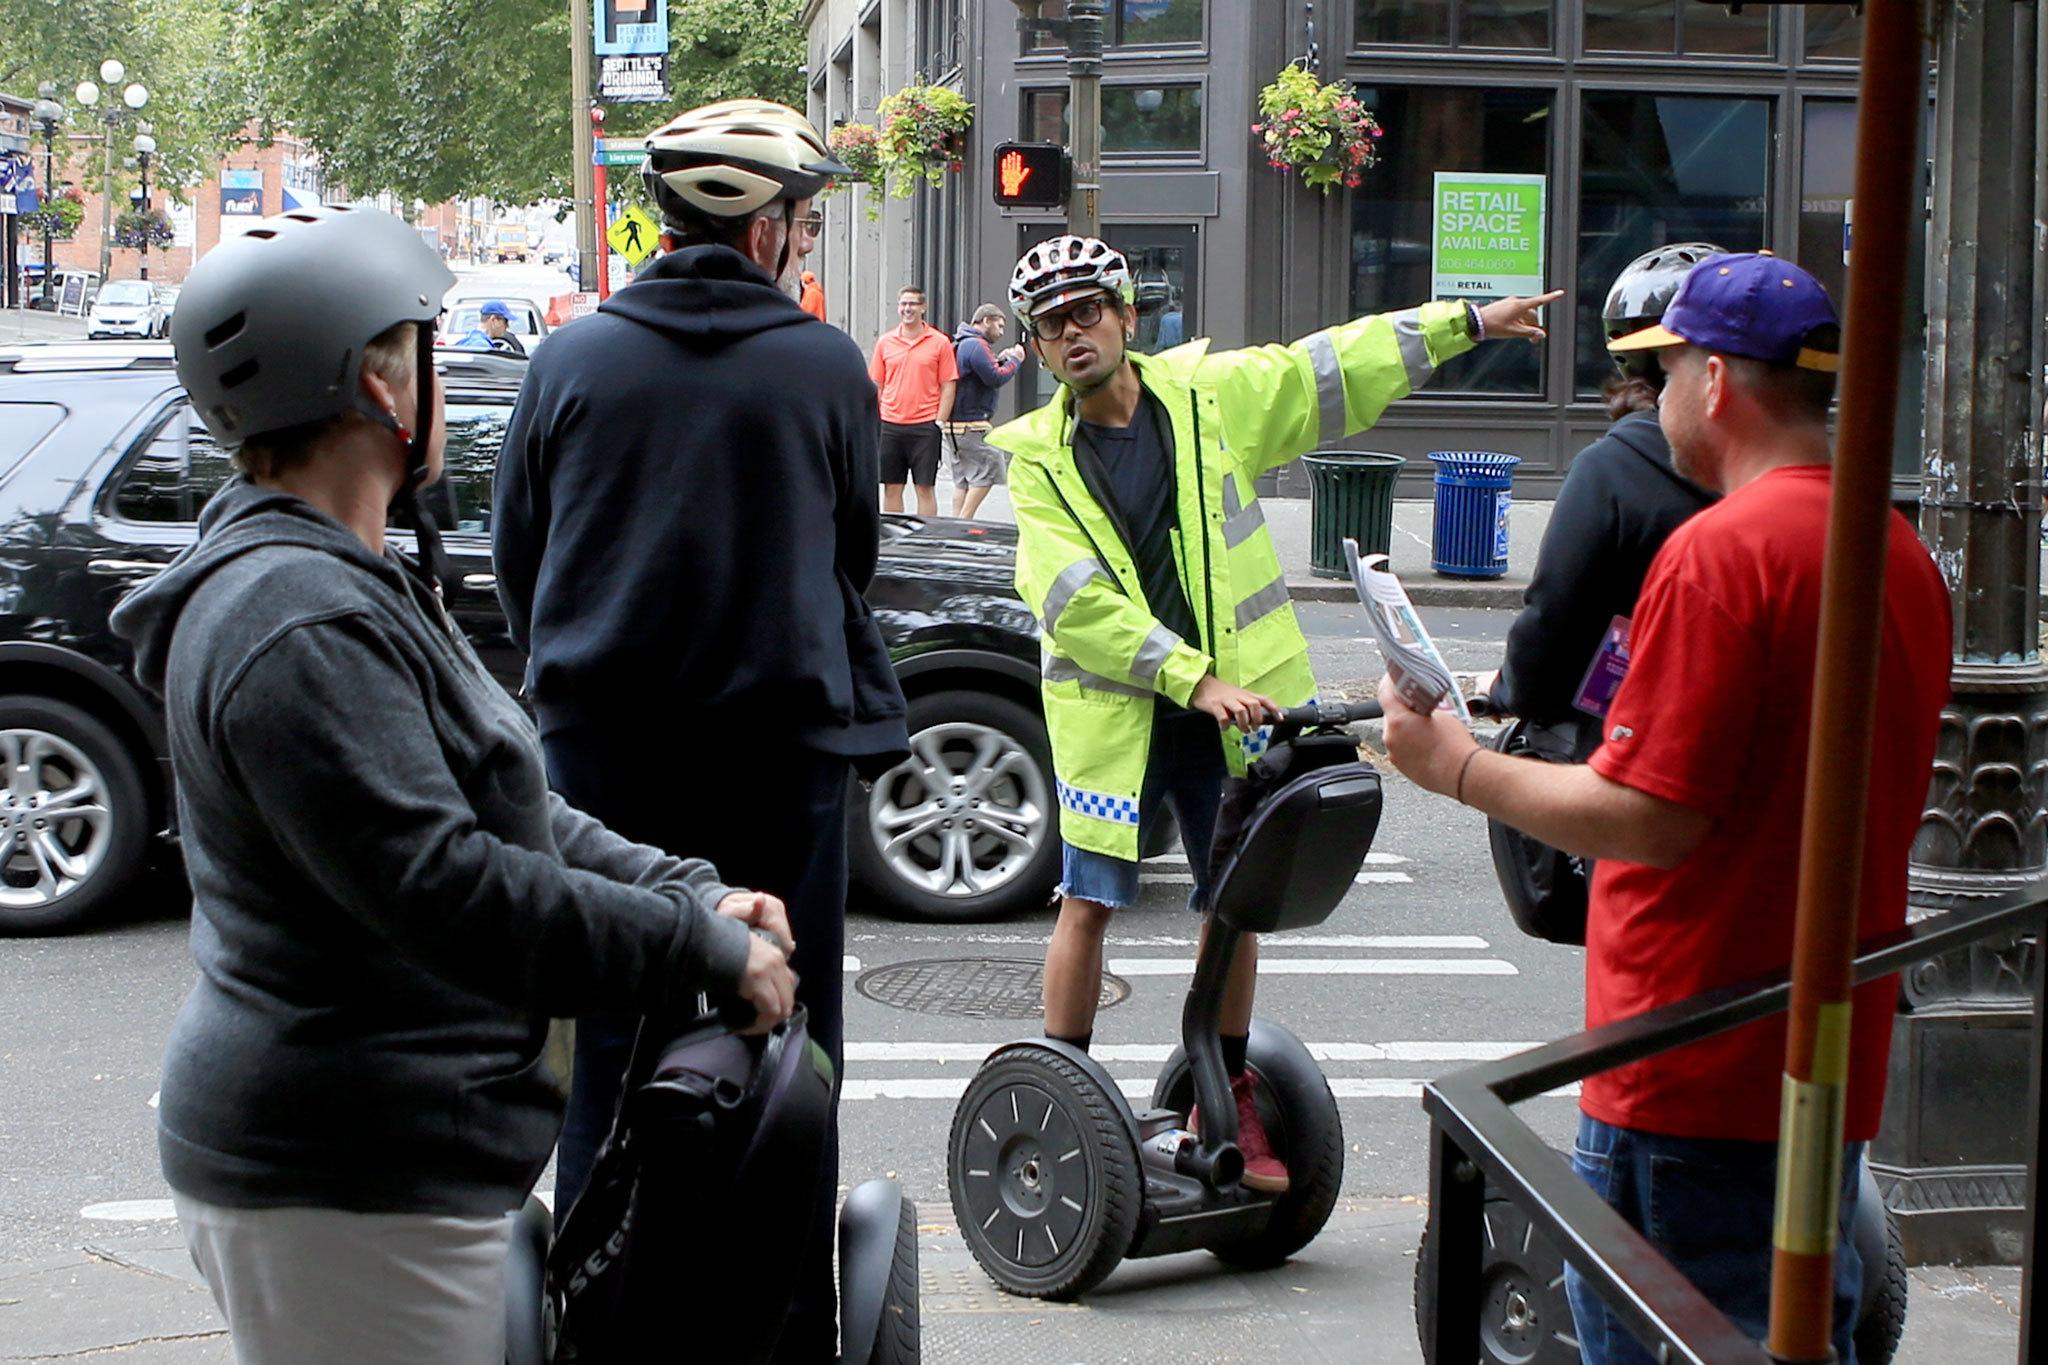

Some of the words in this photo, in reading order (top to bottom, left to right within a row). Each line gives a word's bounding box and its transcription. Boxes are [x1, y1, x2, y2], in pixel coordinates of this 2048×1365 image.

[619, 34, 657, 44] SQUARE
[602, 57, 662, 71] SEATTLE'S
[602, 70, 663, 86] ORIGINAL
[602, 85, 664, 97] NEIGHBORHOOD
[609, 152, 626, 163] king
[1441, 191, 1527, 212] RETAIL
[1441, 212, 1522, 233] SPACE
[1440, 236, 1530, 251] AVAILABLE
[1457, 281, 1493, 290] RETAIL
